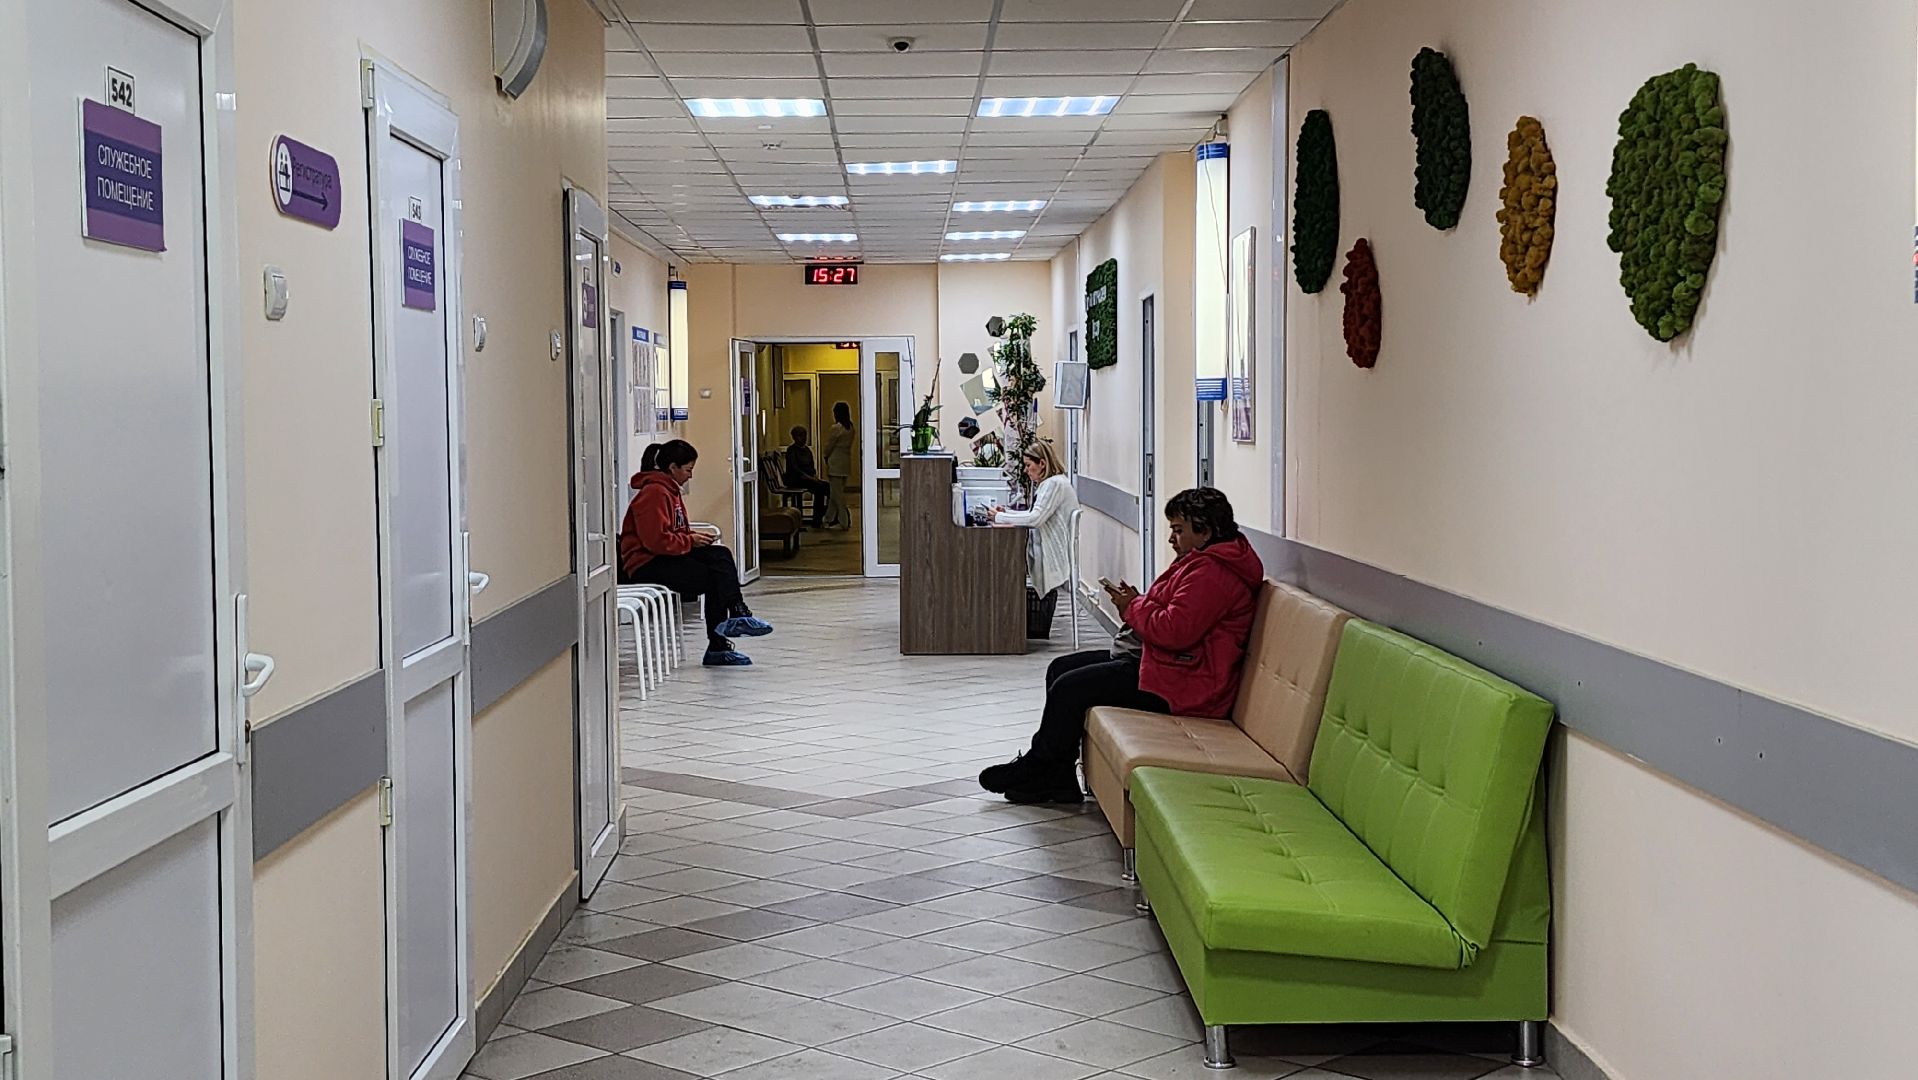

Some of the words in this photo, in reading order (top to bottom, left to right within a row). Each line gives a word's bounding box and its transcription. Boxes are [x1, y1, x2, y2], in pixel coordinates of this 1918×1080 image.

[111, 77, 133, 108] 542
[97, 143, 153, 180] СЛУЖЕБНОЕ
[97, 178, 154, 212] ПОМЕЩЕНИЕ
[812, 267, 855, 283] 15:27
